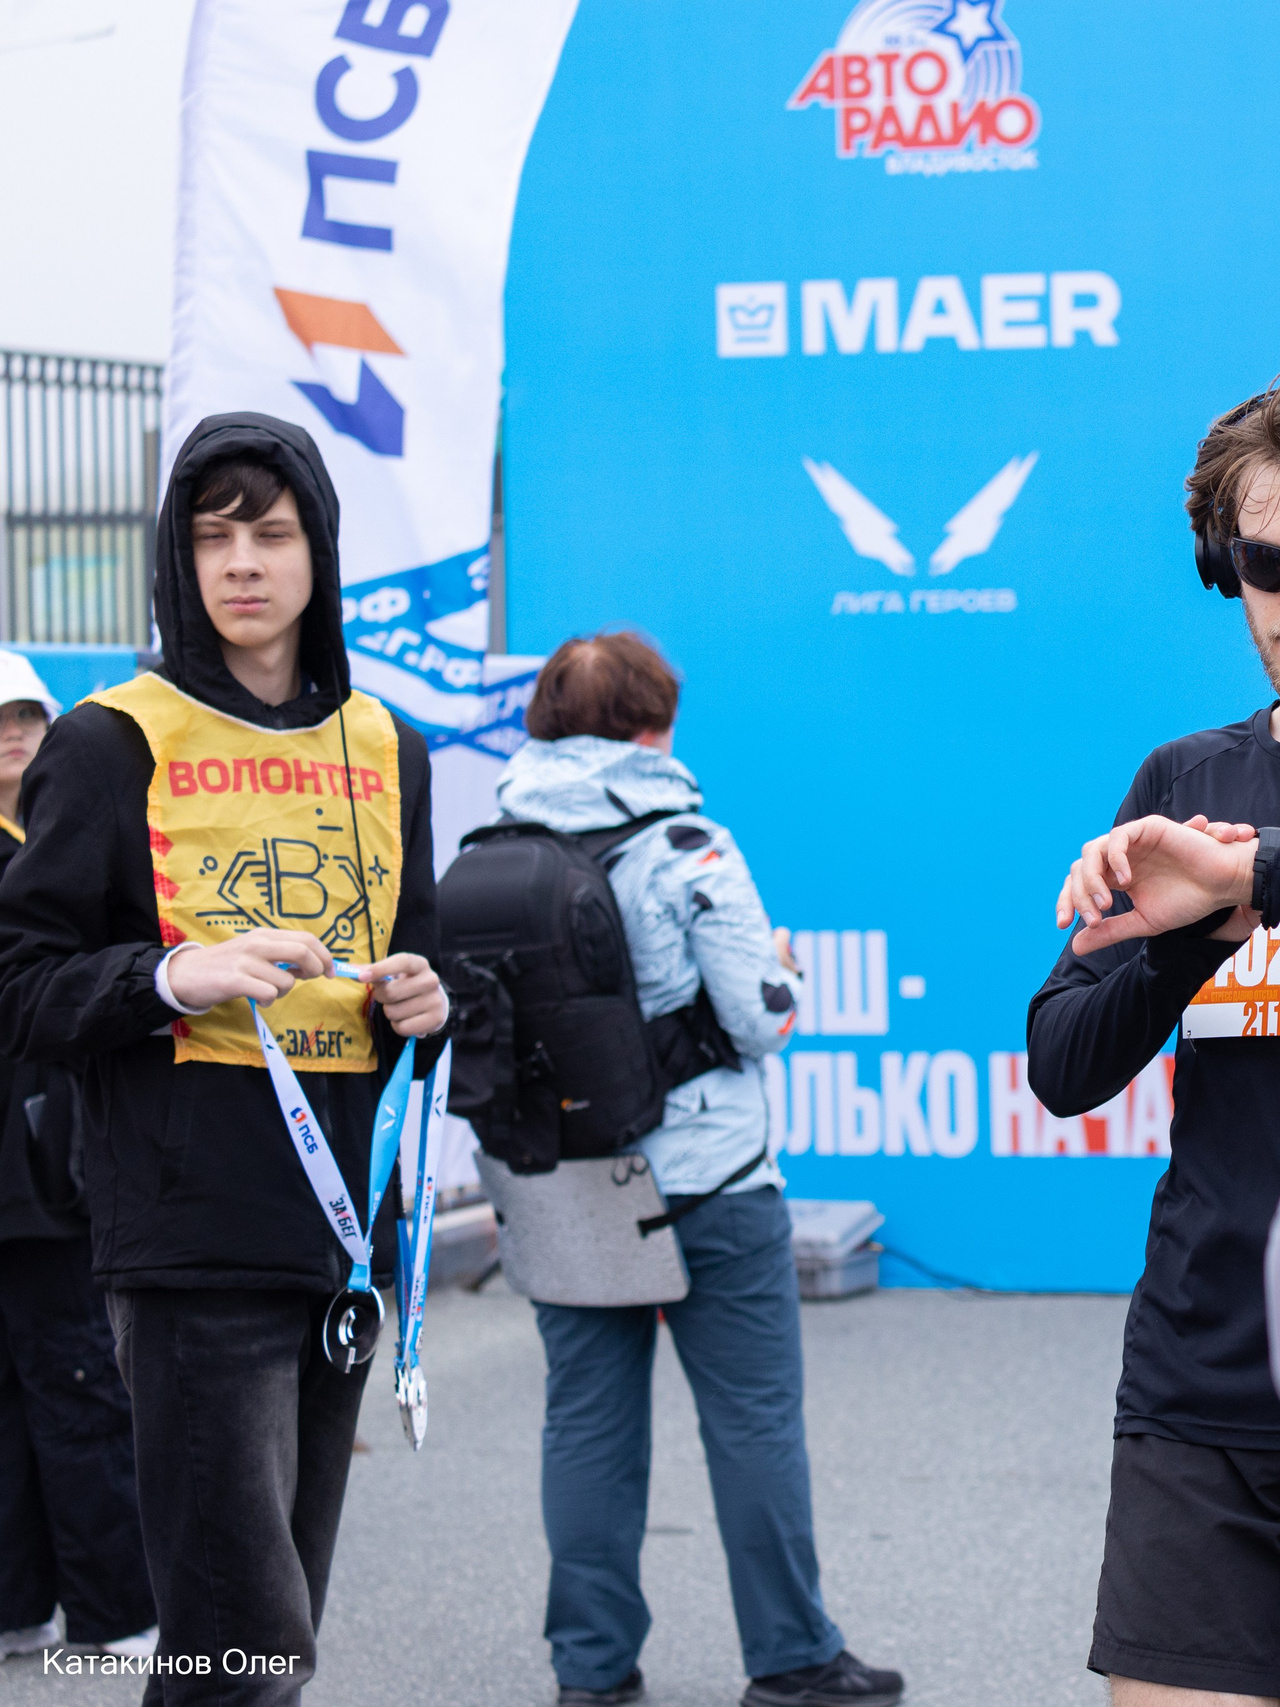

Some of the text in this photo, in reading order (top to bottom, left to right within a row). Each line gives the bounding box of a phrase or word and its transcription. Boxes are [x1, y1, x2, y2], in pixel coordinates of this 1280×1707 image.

[795, 51, 948, 102] АВТО
[301, 0, 451, 253] ПСБ
[842, 98, 1034, 152] РАДИО
[801, 271, 1121, 356] MAER
[831, 587, 1018, 616] ЛИГА ГЕРОЕВ
[168, 757, 385, 802] ВОЛОНТЕР
[299, 1123, 319, 1154] ПСБ
